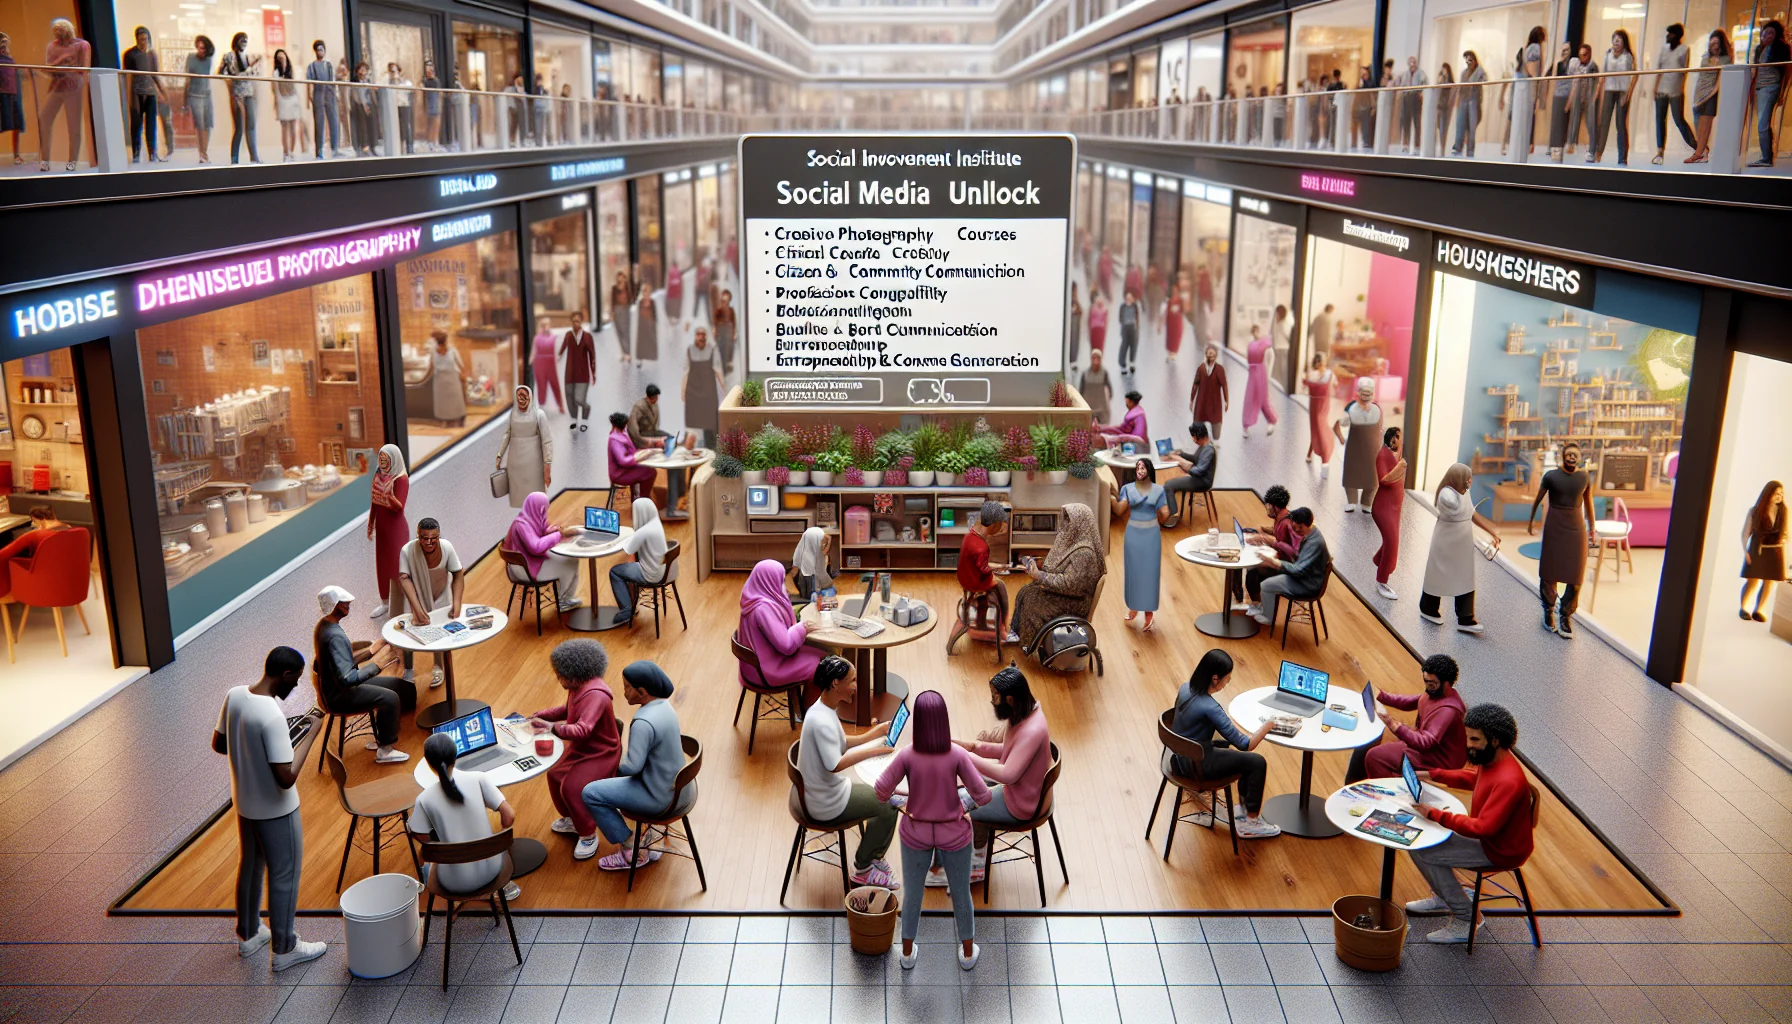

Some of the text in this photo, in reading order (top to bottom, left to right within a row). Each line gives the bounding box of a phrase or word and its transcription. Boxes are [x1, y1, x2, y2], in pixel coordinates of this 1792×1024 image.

[776, 180, 850, 205] Social
[858, 179, 930, 205] Media
[14, 290, 119, 339] HOBISE
